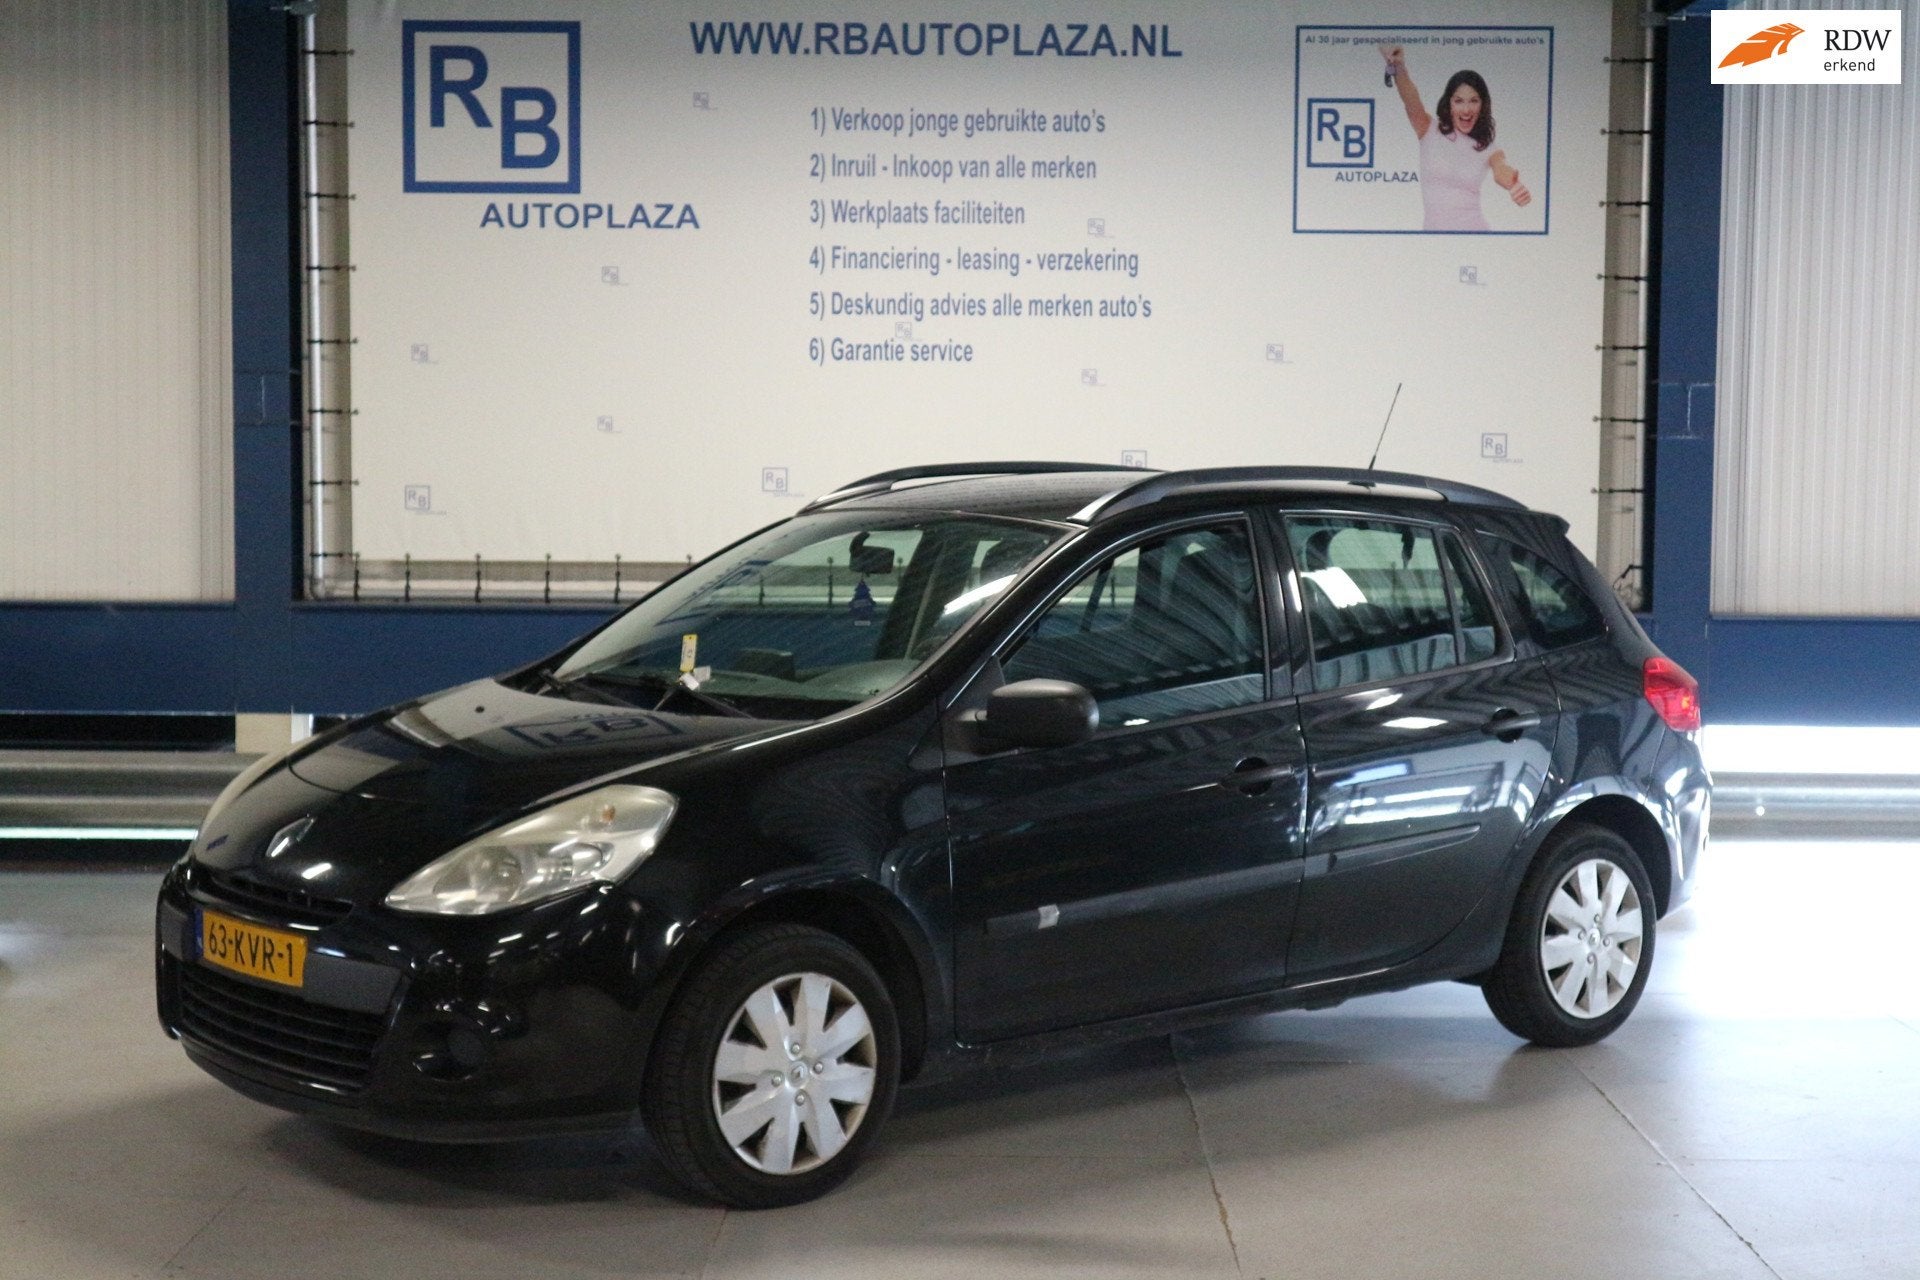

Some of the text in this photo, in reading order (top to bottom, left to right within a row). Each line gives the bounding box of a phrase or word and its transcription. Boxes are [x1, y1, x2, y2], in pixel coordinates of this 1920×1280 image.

[690, 21, 1183, 57] WWW.RBAUTOPLAZA.NL
[1319, 35, 1329, 44] 30
[1332, 36, 1350, 46] jaar
[1431, 35, 1440, 44] in
[1443, 36, 1464, 46] jong
[1467, 36, 1512, 46] gebruikte
[810, 108, 1106, 138] 1) Verkoop jonge gebruikte auto's
[810, 153, 826, 182] 2)
[831, 154, 876, 177] Inruil
[893, 155, 953, 183] Inkoop
[959, 160, 990, 178] van
[996, 156, 1026, 179] alle
[1032, 156, 1097, 180] merken
[1335, 171, 1419, 183] AUTOPLAZA
[480, 202, 700, 230] AUTOPLAZA
[810, 199, 1025, 229] 3) Werkplaats faciliteiten
[809, 246, 825, 275] 4)
[831, 245, 940, 277] Financiering
[957, 247, 1019, 278] leasing
[1037, 248, 1139, 279] verzekering
[810, 291, 1152, 322] 5) Deskundig advies alle merken auto's
[809, 337, 974, 367] 6) Garantie service
[209, 922, 293, 978] 63-KVR-1
